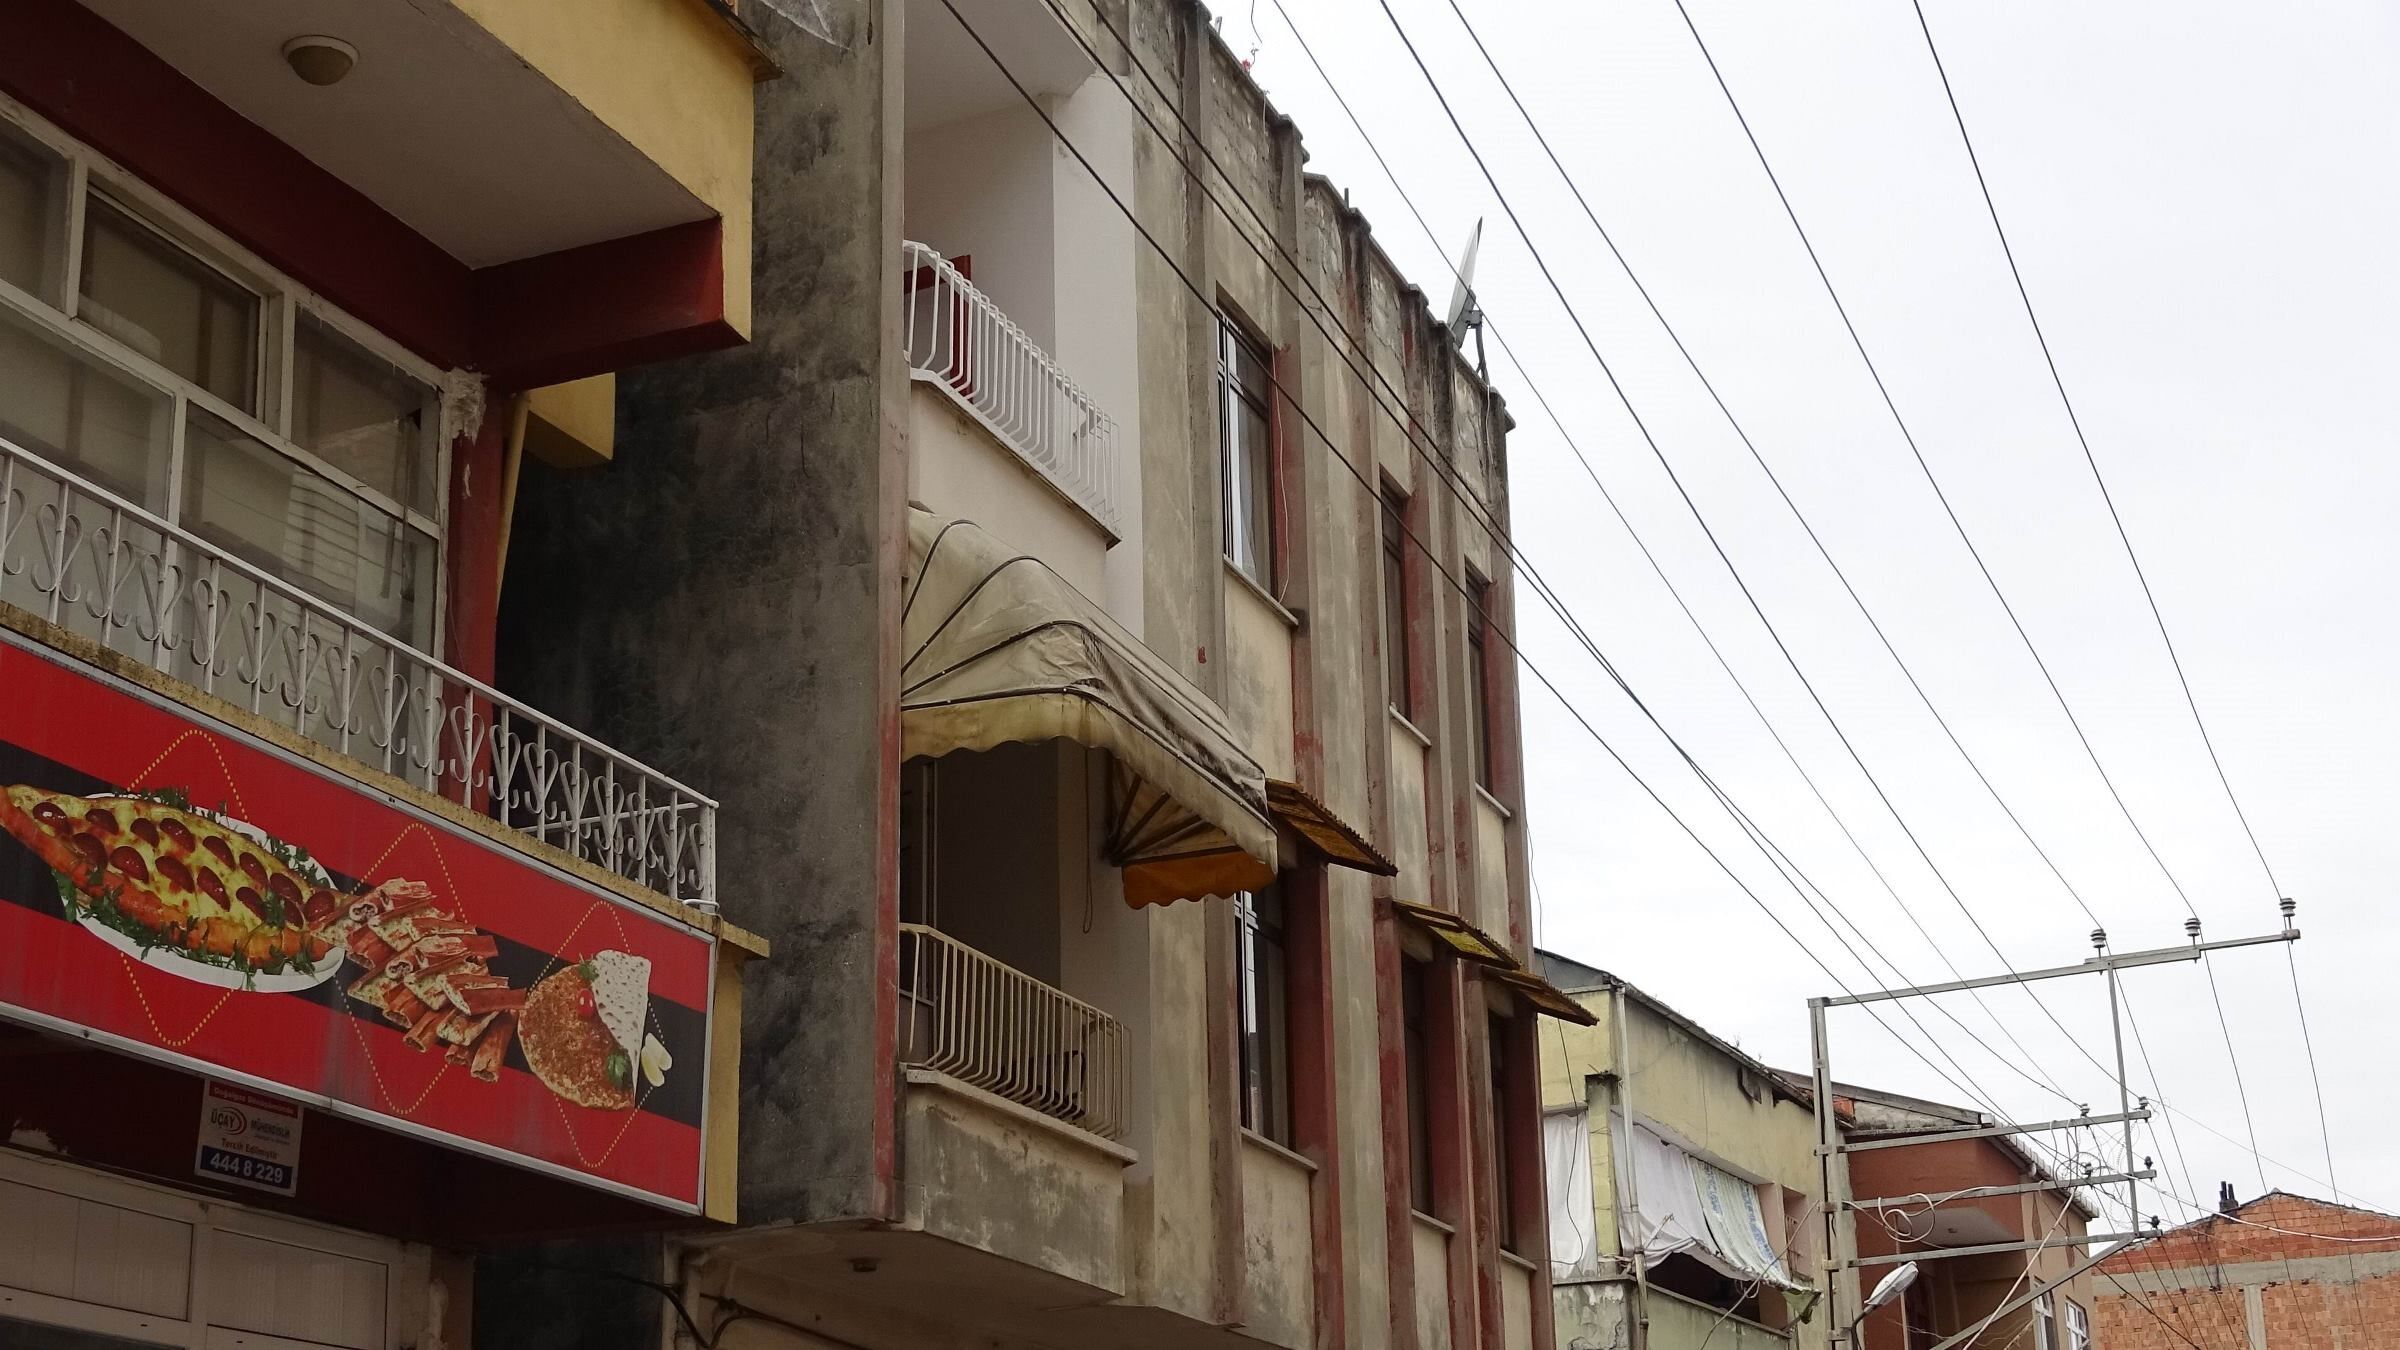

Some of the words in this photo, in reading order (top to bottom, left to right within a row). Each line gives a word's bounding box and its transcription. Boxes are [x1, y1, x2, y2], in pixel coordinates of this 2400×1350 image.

[210, 1109, 235, 1129] ÜÇAY
[210, 1152, 240, 1173] 444
[243, 1160, 253, 1177] 8
[255, 1164, 284, 1184] 229
